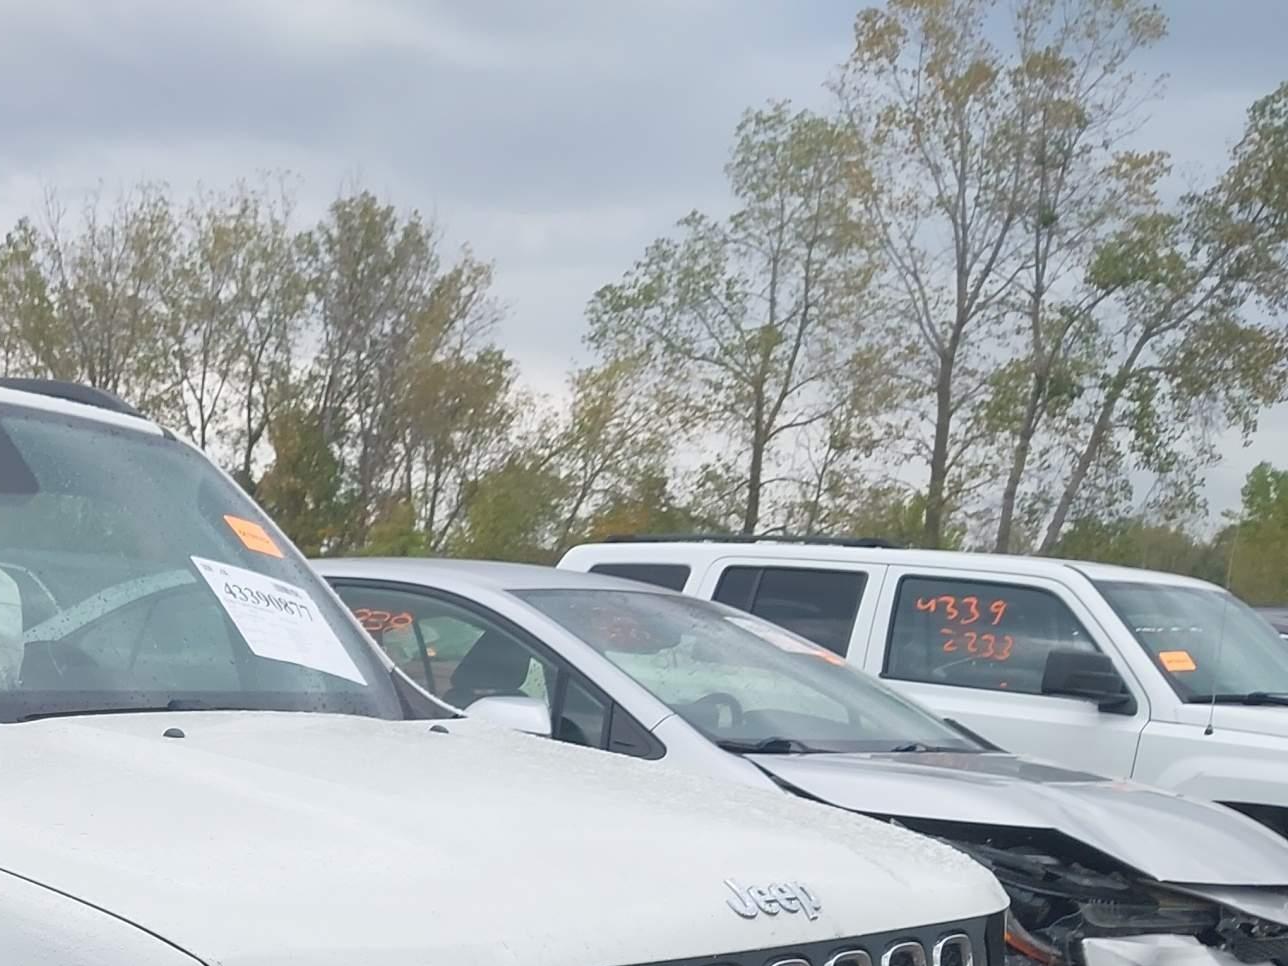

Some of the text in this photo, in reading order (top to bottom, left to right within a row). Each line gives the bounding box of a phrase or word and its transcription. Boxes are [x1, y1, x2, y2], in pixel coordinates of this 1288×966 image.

[224, 582, 313, 621] 43390877
[916, 595, 1007, 625] 4339
[722, 878, 821, 921] Jeep
